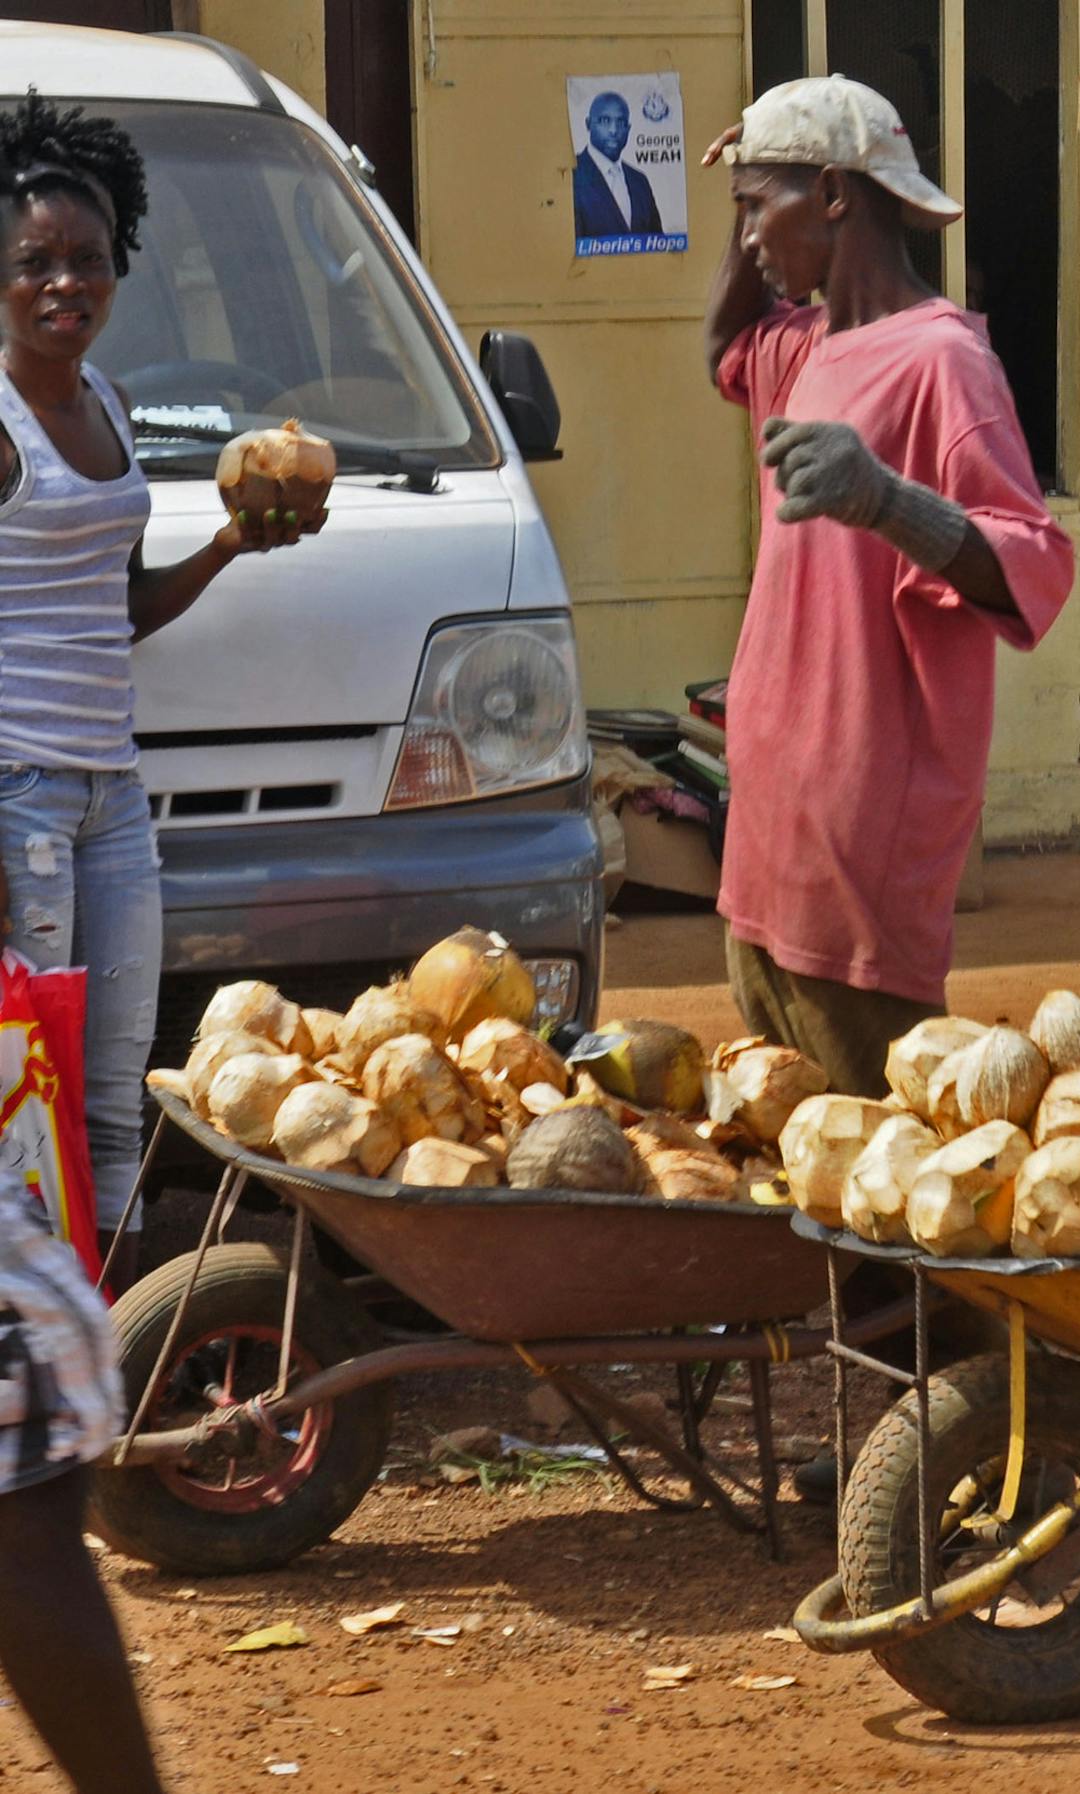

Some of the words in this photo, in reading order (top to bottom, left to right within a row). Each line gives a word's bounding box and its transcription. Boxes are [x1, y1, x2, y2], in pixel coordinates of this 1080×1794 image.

[636, 134, 680, 149] George
[635, 150, 681, 164] WEAH
[578, 237, 642, 255] Liberia's
[645, 235, 685, 252] Hope
